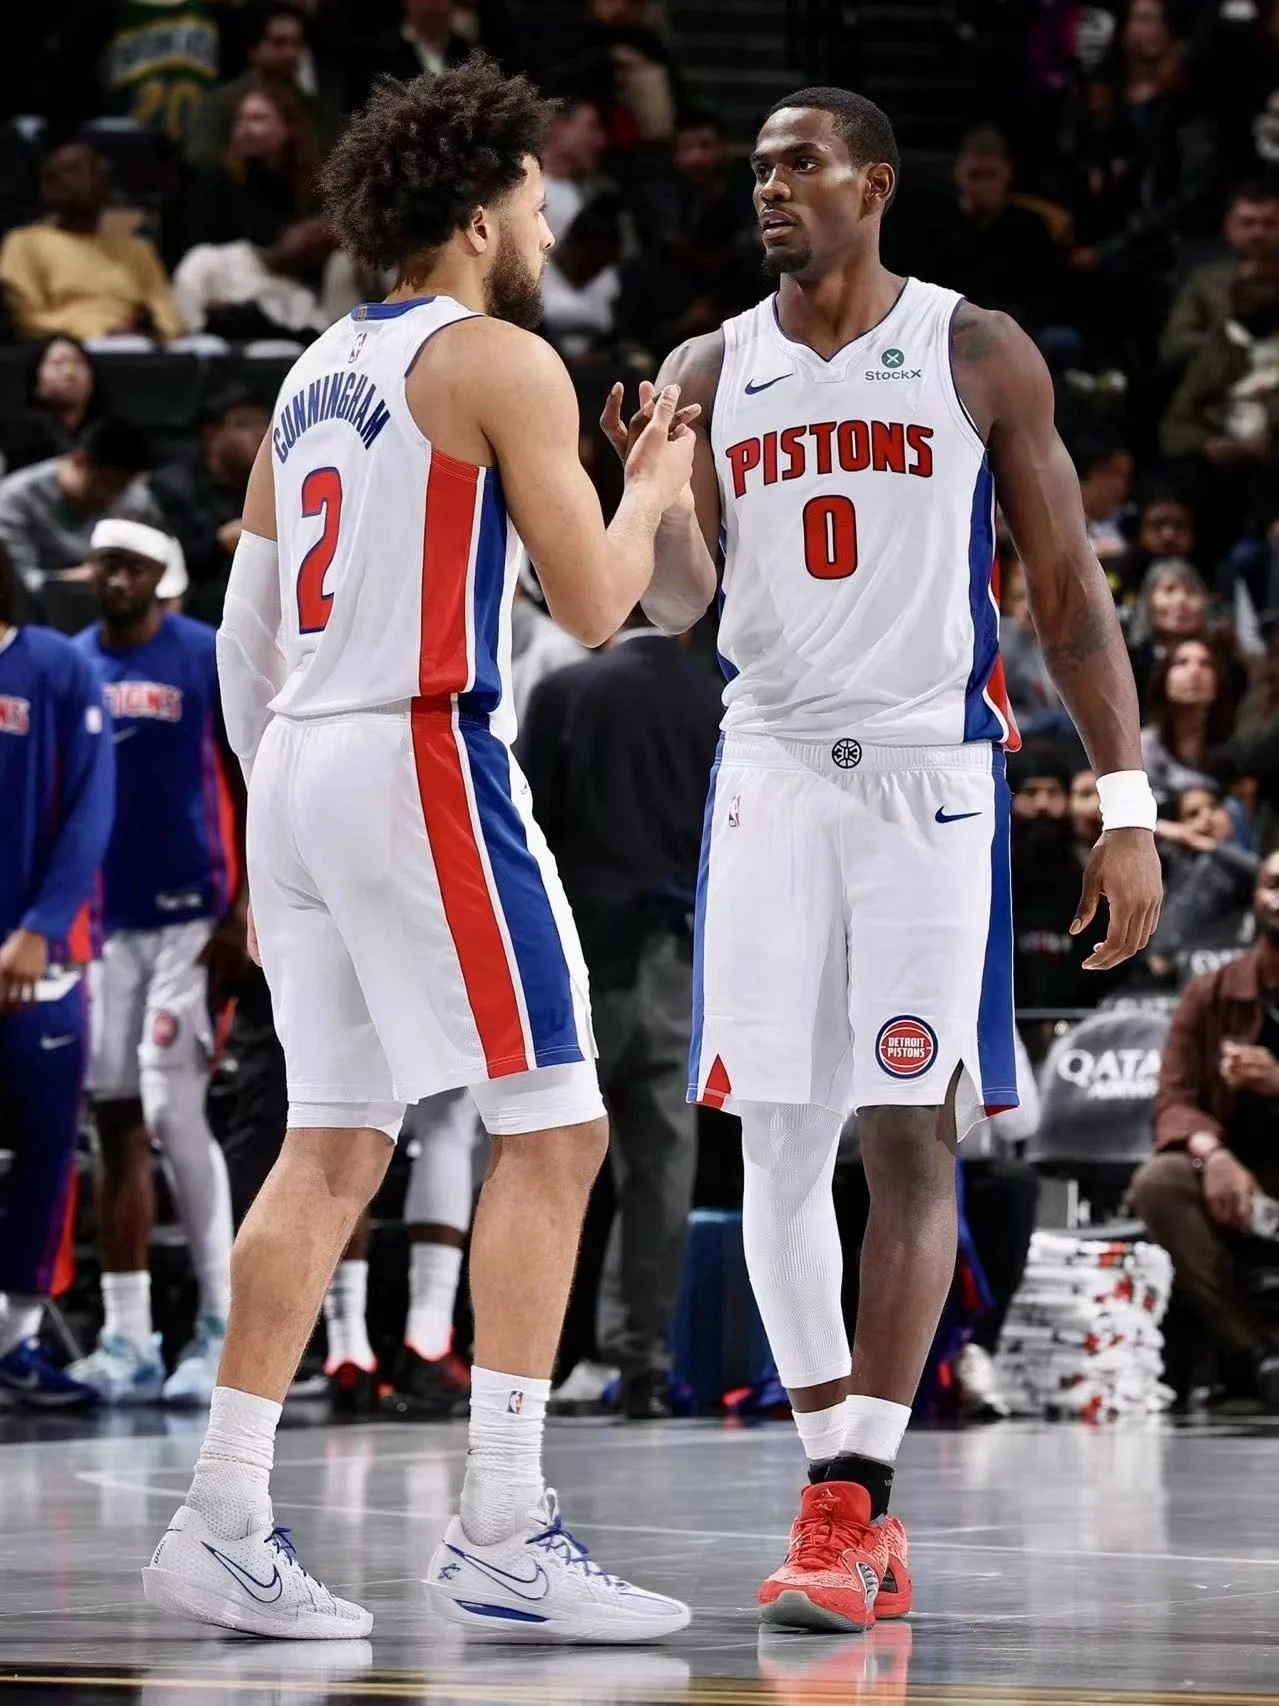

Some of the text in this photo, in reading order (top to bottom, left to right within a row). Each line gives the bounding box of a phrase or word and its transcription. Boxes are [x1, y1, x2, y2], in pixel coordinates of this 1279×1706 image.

[864, 369, 922, 382] StockX
[273, 371, 391, 464] CUNNINGHAM
[726, 420, 934, 499] PISTONS
[296, 466, 343, 635] 2
[802, 494, 858, 581] 0
[887, 1037, 925, 1048] DETROIT
[887, 1047, 925, 1058] PISTONS
[1057, 1049, 1162, 1088] QATA
